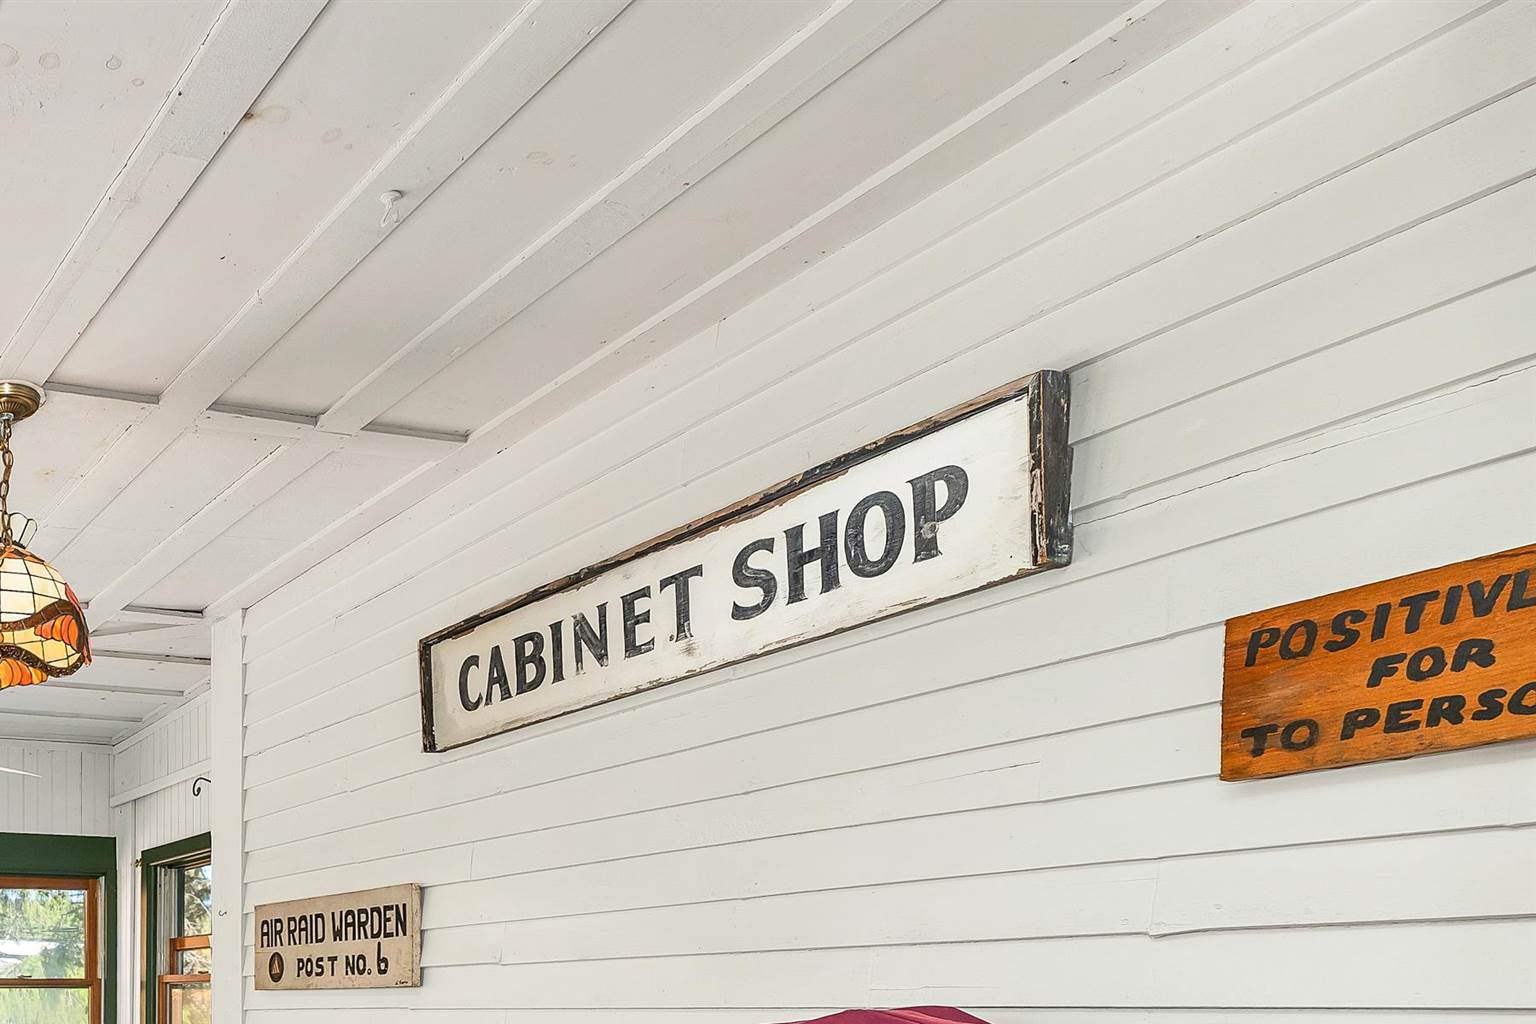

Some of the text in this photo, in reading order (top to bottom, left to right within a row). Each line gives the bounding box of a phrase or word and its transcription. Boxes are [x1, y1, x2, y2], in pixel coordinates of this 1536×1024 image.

[458, 464, 969, 713] CABINET SHOP
[1366, 638, 1496, 688] FOR
[1241, 719, 1320, 757] TO
[260, 903, 407, 948] AIR RAID WARDEN
[296, 956, 338, 978] POST
[345, 954, 372, 976] NO.
